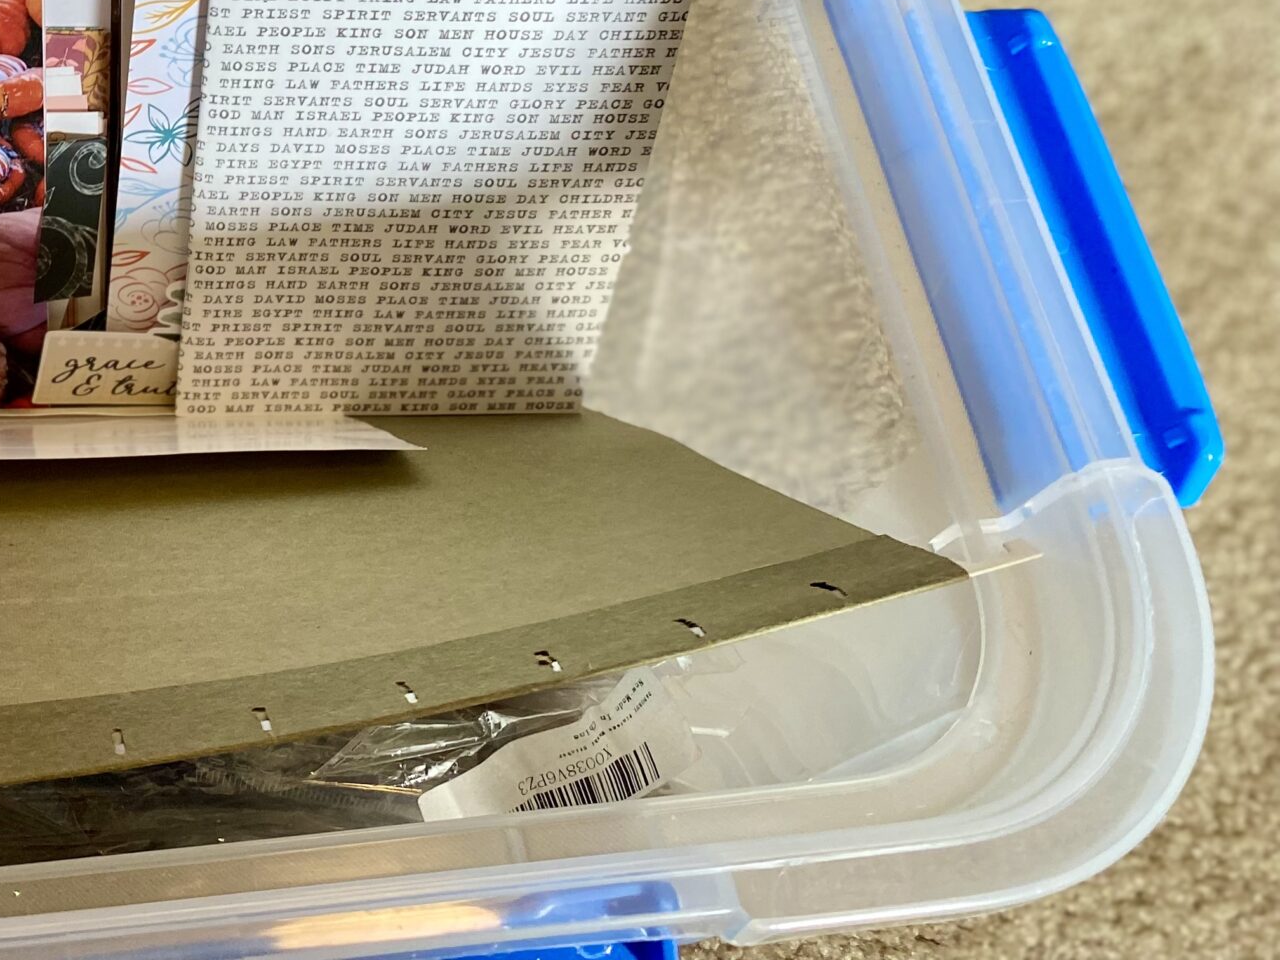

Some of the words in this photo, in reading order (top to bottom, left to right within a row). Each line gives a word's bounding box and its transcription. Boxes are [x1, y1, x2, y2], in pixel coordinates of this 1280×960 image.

[241, 8, 310, 19] PRIEST
[322, 10, 391, 20] SPIRIT
[403, 11, 496, 22] SERVANTS
[508, 12, 554, 22] SOUL
[566, 12, 647, 22] SERVANT
[256, 27, 326, 37] PEOPLE
[336, 28, 382, 38] KING
[394, 28, 428, 39] SON
[439, 30, 474, 40] MEN
[484, 30, 543, 40] HOUSE
[552, 30, 588, 40] DAY
[221, 61, 276, 72] MOSES
[288, 62, 344, 72] PLACE
[356, 63, 400, 73] TIME
[412, 64, 470, 74] JUDAH
[482, 65, 526, 75] WORD
[536, 65, 582, 75] EVIL
[592, 65, 662, 76] HEAVEN
[220, 78, 274, 88] THING
[286, 79, 319, 89] LAW
[330, 80, 408, 90] FATHERS
[420, 81, 465, 91] LIFE
[476, 82, 533, 92] HANDS
[543, 83, 588, 92] EYES
[600, 83, 644, 92] FEAR
[264, 96, 352, 106] SERVANTS
[364, 97, 408, 107] SOUL
[420, 98, 498, 109] SERVANT
[510, 99, 566, 109] GLORY
[575, 100, 633, 109] PEACE
[208, 109, 240, 120] GOD
[252, 111, 284, 120] MAN
[296, 111, 361, 121] ISRAEL
[372, 112, 440, 122] PEOPLE
[450, 113, 494, 123] KING
[506, 114, 539, 123] SON
[549, 114, 584, 124] MEN
[593, 114, 650, 124] HOUSE
[239, 192, 303, 200] PEOPLE
[313, 192, 356, 202] KING
[368, 193, 399, 202] SON
[409, 194, 442, 203] MEN
[452, 194, 506, 204] HOUSE
[516, 194, 549, 204] DAY
[195, 280, 255, 289] THINGS
[266, 280, 307, 289] HAND
[317, 281, 369, 290] EARTH
[379, 282, 420, 290] SONS
[430, 282, 525, 291] JERUSALEM
[535, 282, 576, 290] CITY
[51, 356, 166, 384] grace
[518, 746, 612, 796] X0038V6PZ3
